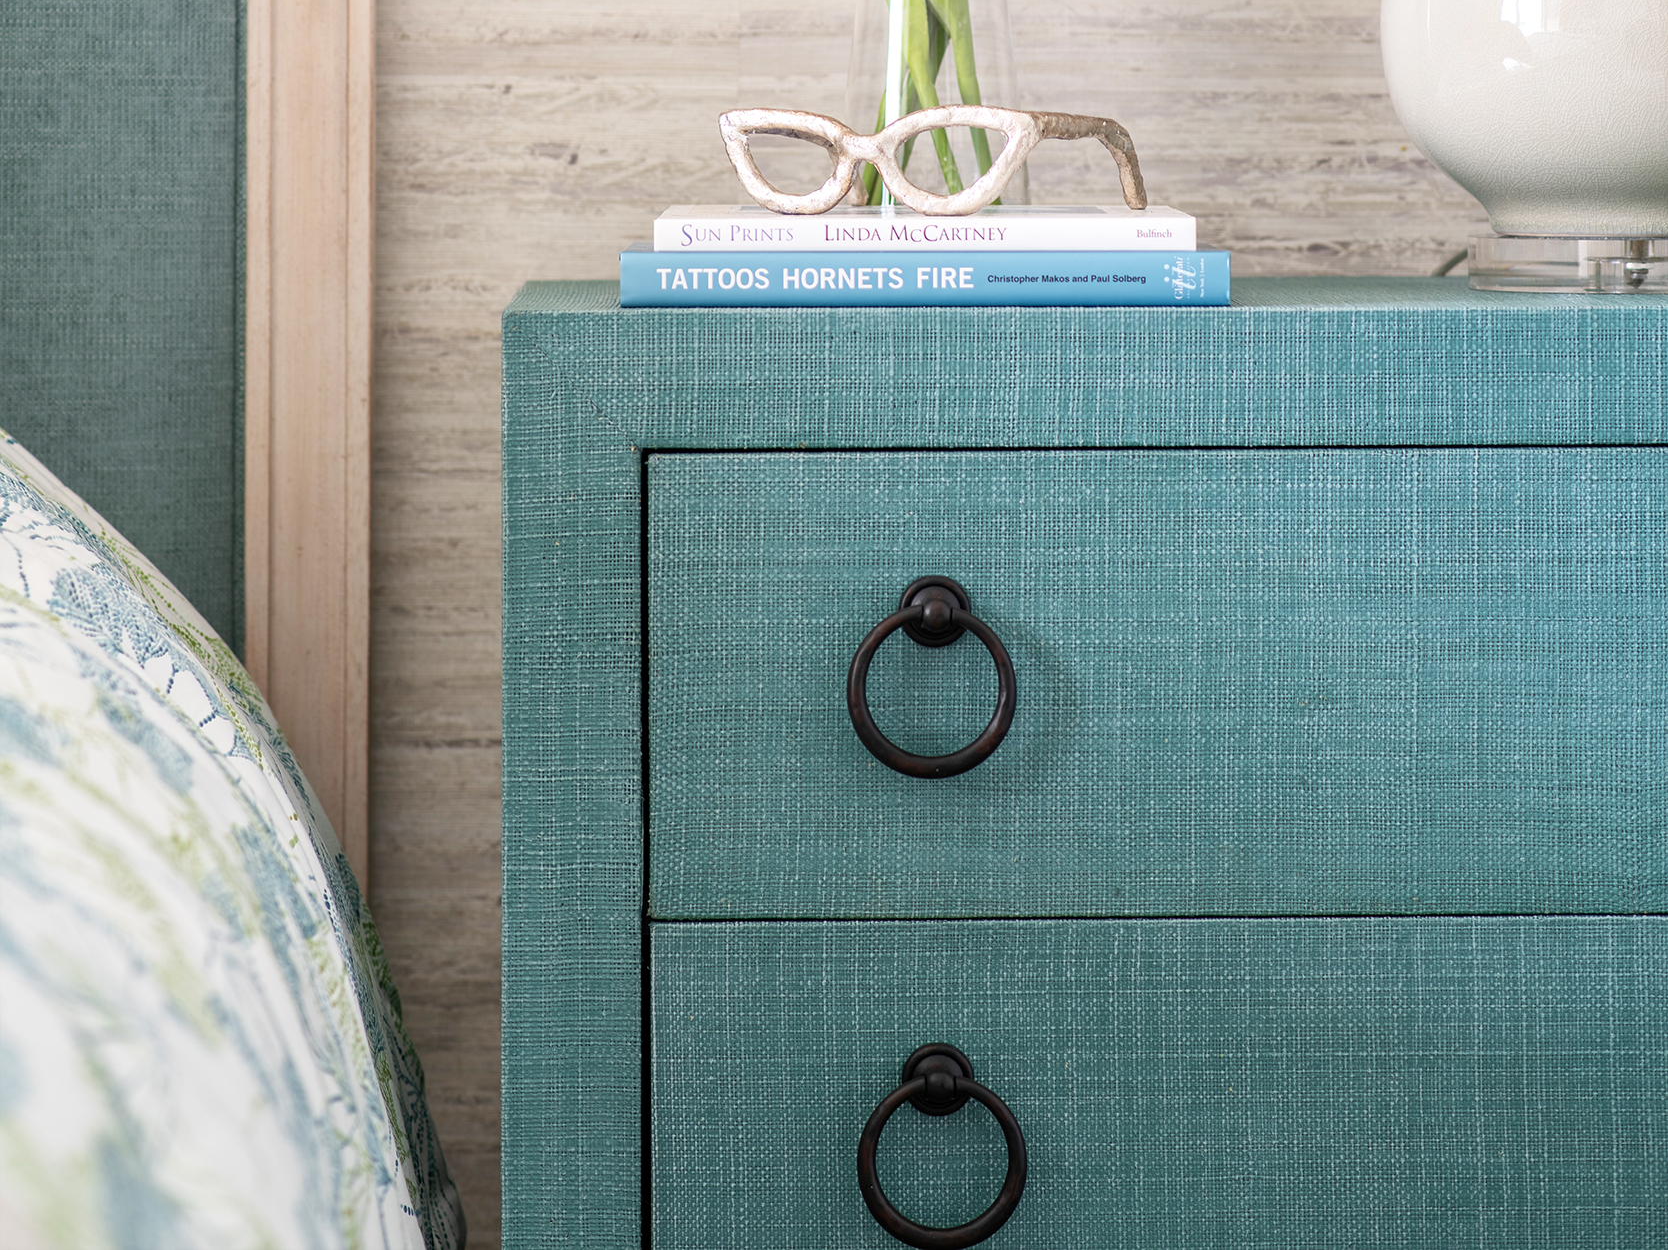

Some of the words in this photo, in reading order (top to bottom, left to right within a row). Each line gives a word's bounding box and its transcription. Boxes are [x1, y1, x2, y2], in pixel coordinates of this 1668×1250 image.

[681, 223, 722, 247] SUN
[730, 224, 794, 242] PRINTS
[824, 224, 882, 242] LINDA
[1136, 228, 1173, 238] Bulfinch
[656, 267, 770, 290] TATTOOS
[782, 267, 904, 290] HORNETS
[916, 266, 975, 289] FIRE
[987, 274, 1039, 285] Christopher
[1041, 274, 1070, 283] Makos
[1071, 274, 1089, 283] and
[1090, 274, 1110, 283] Paul
[1112, 274, 1147, 285] Solberg
